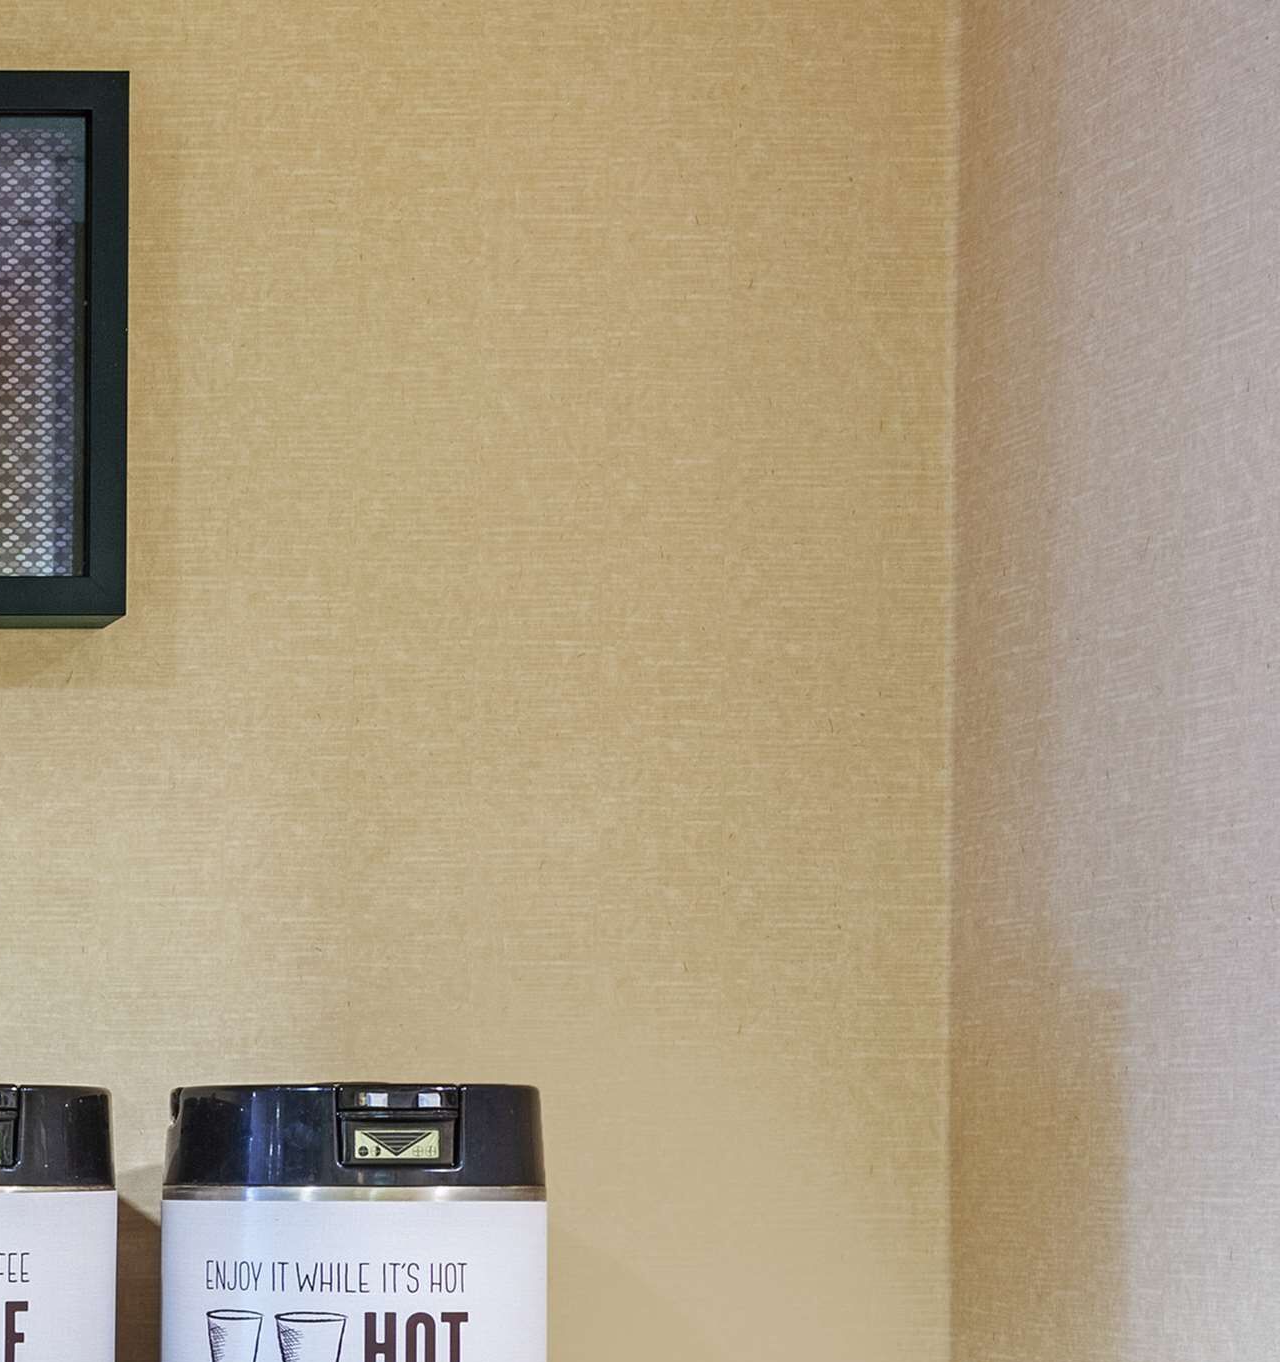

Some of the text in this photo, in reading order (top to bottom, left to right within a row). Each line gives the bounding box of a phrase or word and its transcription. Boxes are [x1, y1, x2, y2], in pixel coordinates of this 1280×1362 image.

[205, 1260, 468, 1294] ENJOY IT WHILE IT'S HOT
